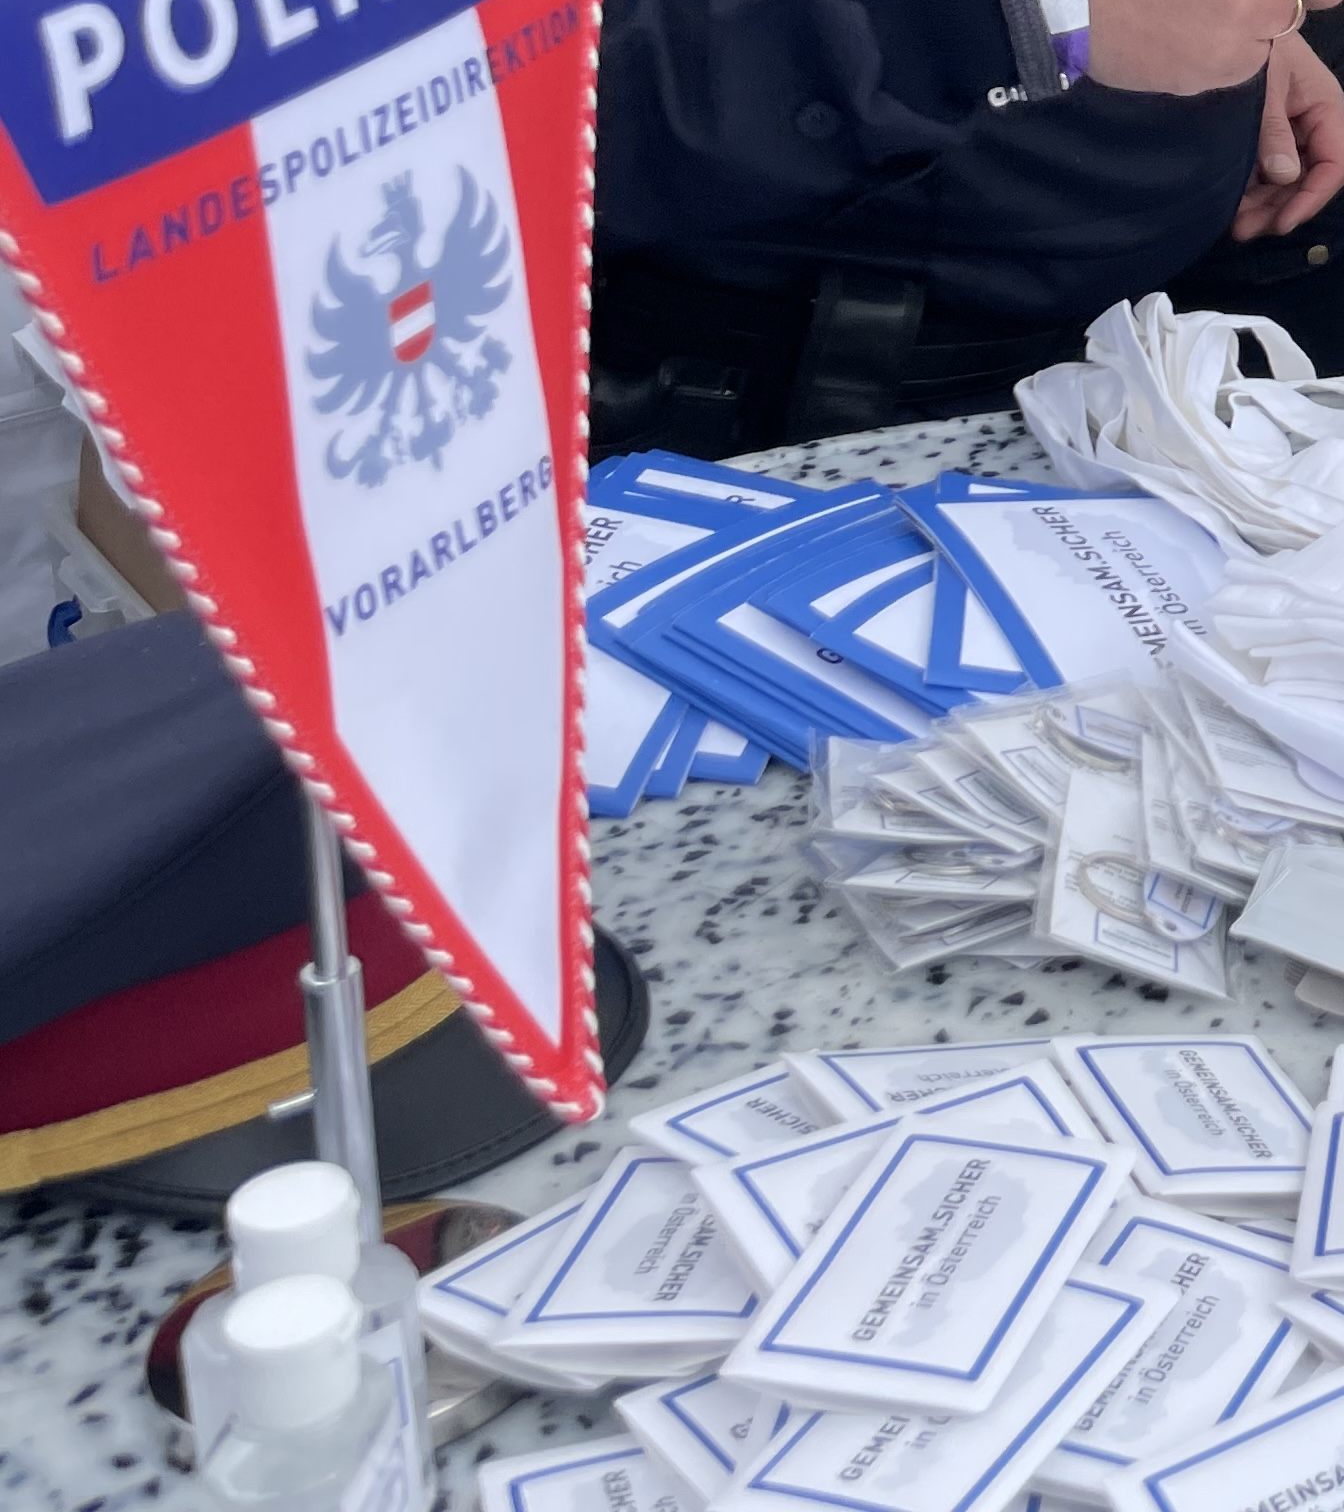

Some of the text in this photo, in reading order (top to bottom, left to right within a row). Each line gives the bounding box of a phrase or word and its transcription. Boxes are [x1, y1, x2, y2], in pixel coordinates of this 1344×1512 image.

[91, 7, 582, 284] LANDESPOLIZEIDIREKTION
[326, 455, 555, 638] VORARLBERG
[1101, 530, 1189, 615] Österreich
[1165, 1068, 1228, 1137] in Österreich
[1179, 1049, 1274, 1160] GEMEINSAM.SICHER
[634, 1207, 696, 1275] Österreich
[851, 1158, 991, 1342] GEMEINSAM.SICHER
[910, 1195, 1002, 1310] in Österreich
[1128, 1294, 1221, 1406] in Österreich
